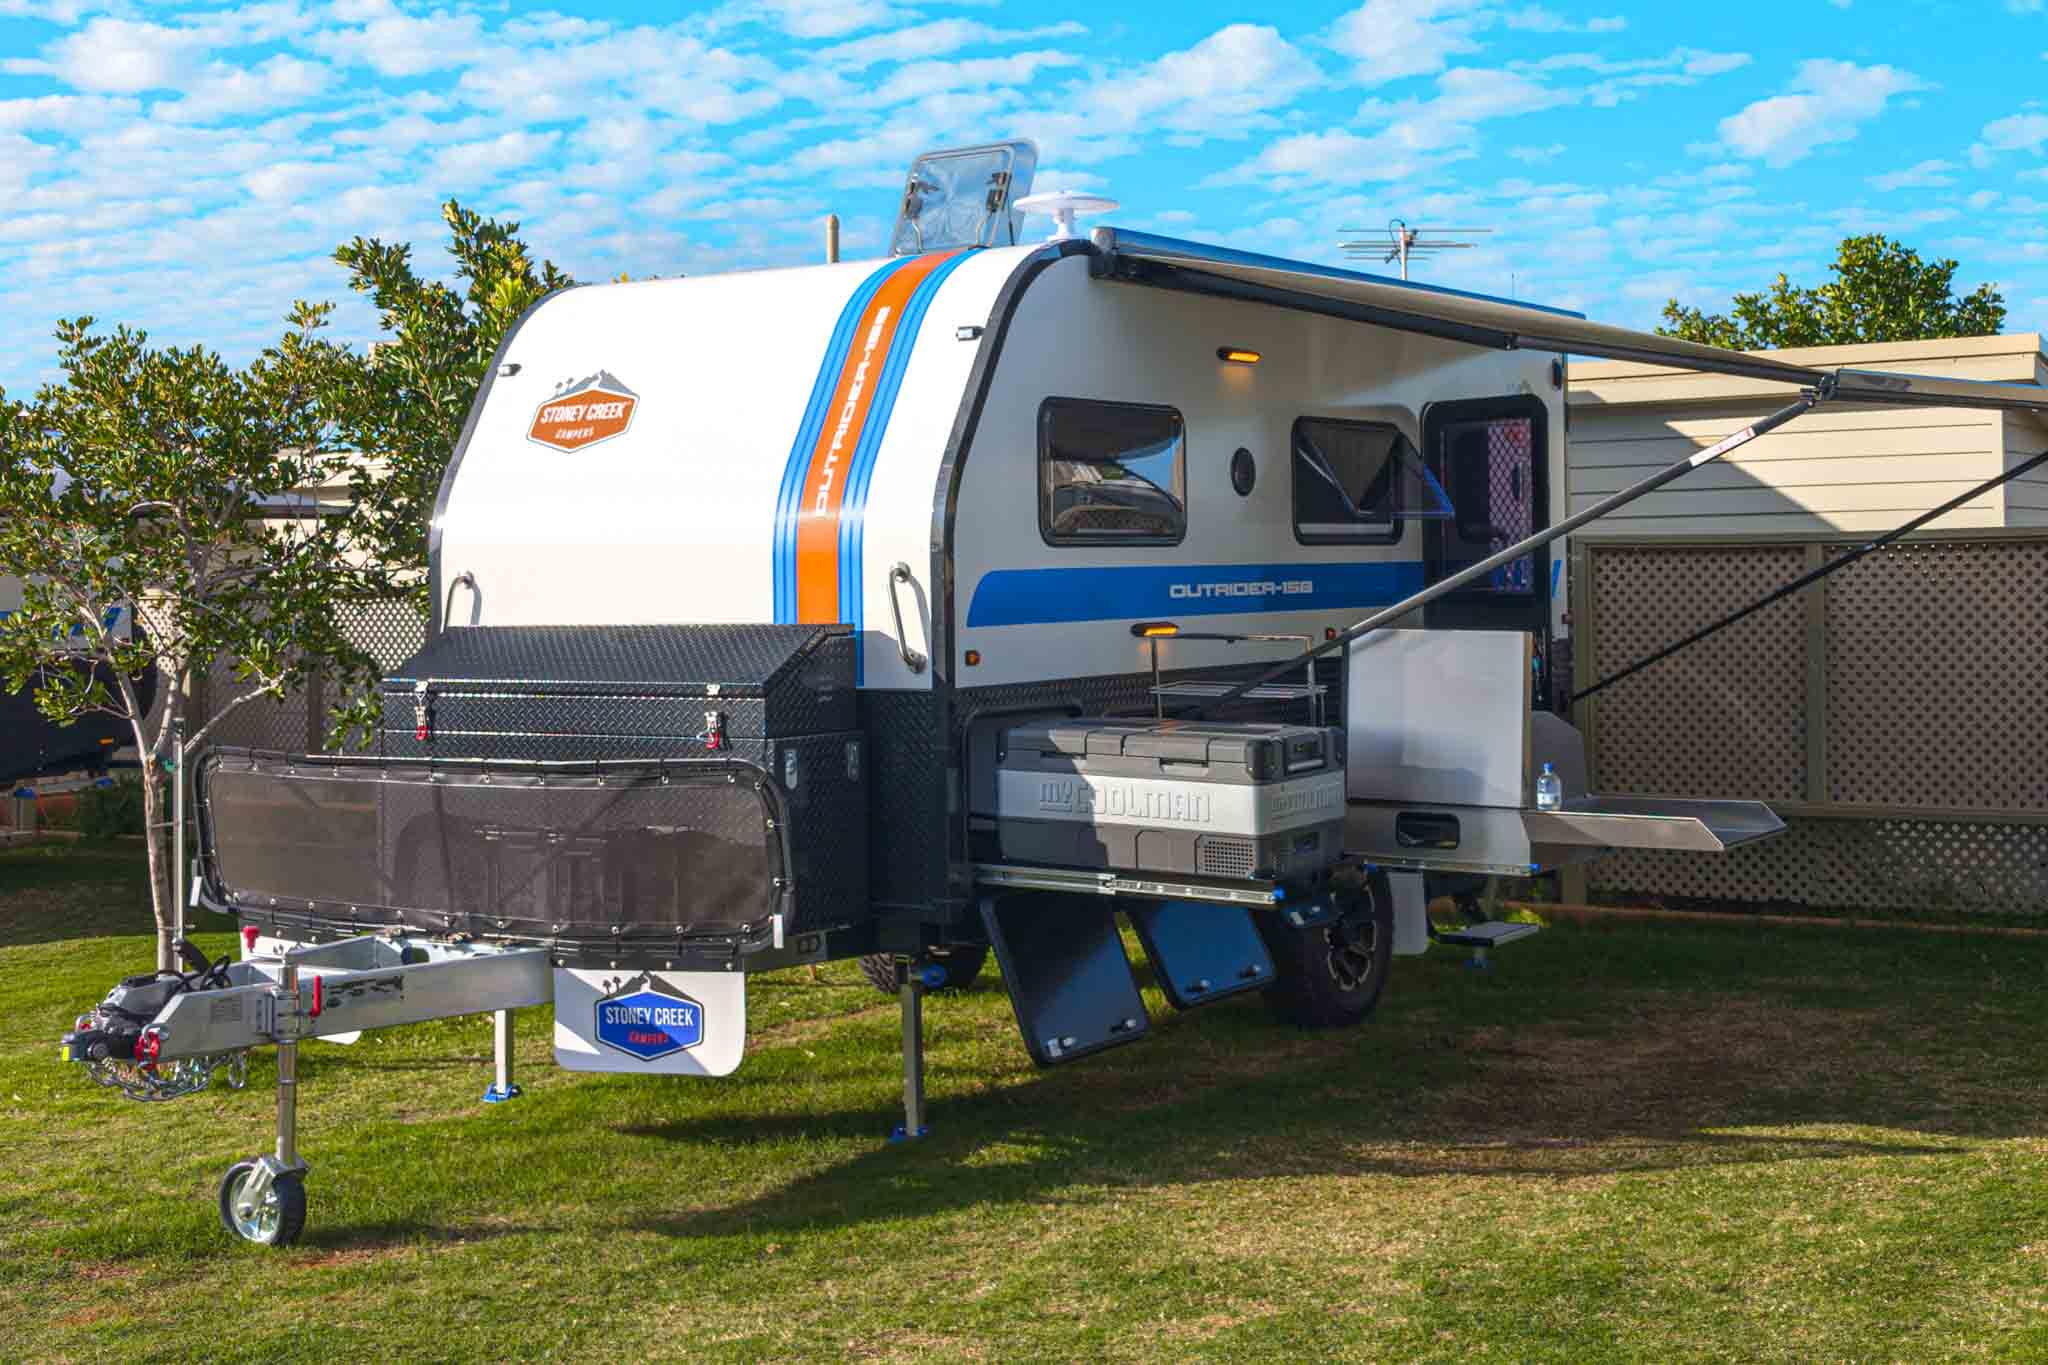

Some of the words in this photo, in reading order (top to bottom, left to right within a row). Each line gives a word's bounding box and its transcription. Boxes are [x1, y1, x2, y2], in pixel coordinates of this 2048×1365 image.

[540, 404, 588, 424] STONEY
[586, 401, 627, 421] CREEK
[605, 1007, 651, 1025] STONEY
[654, 1007, 694, 1026] CREEK
